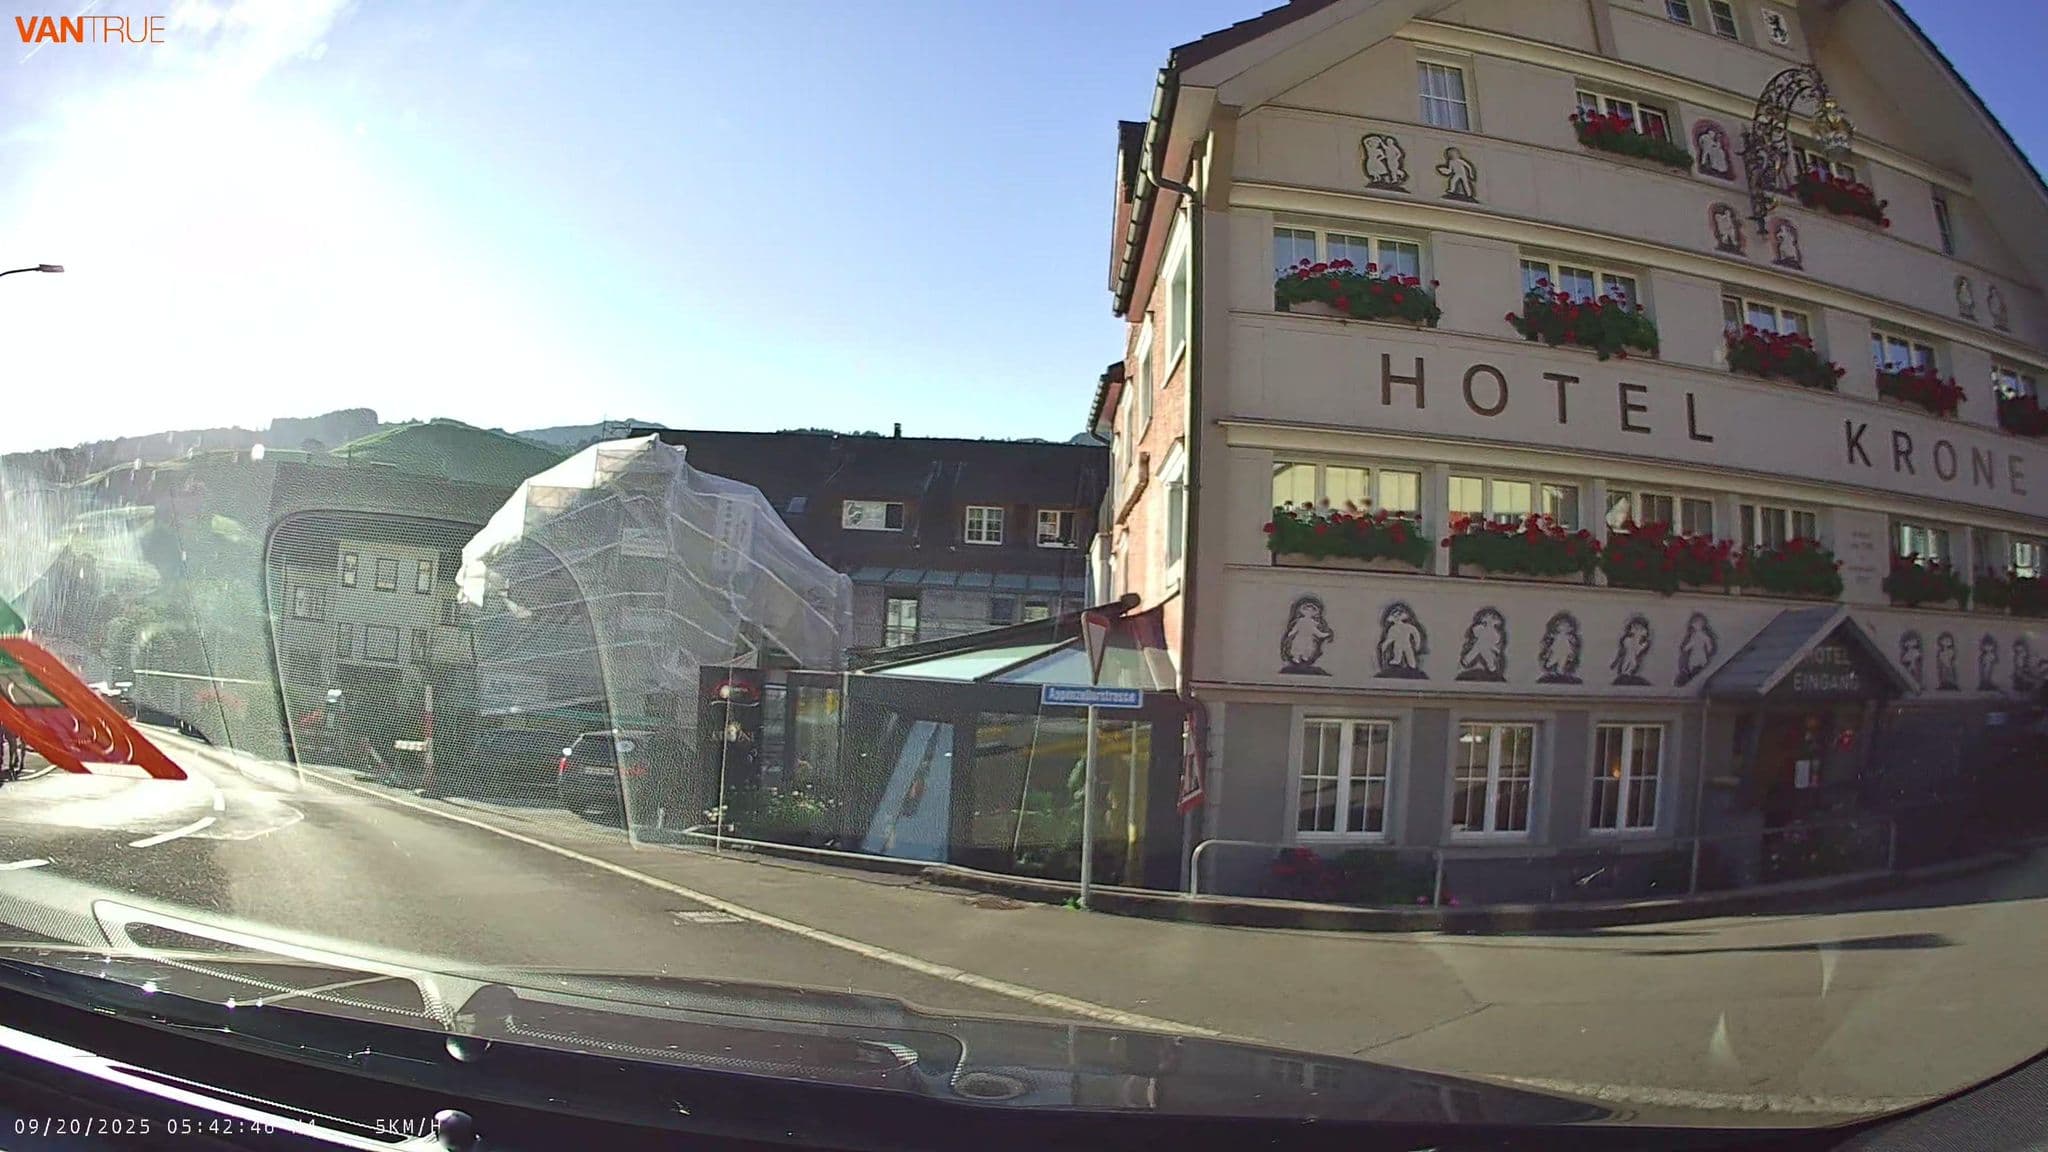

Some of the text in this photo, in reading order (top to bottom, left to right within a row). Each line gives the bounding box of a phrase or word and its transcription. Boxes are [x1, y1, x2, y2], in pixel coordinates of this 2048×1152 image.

[1380, 353, 2029, 497] HOTEL KRONE
[1793, 672, 1860, 691] EINGANG
